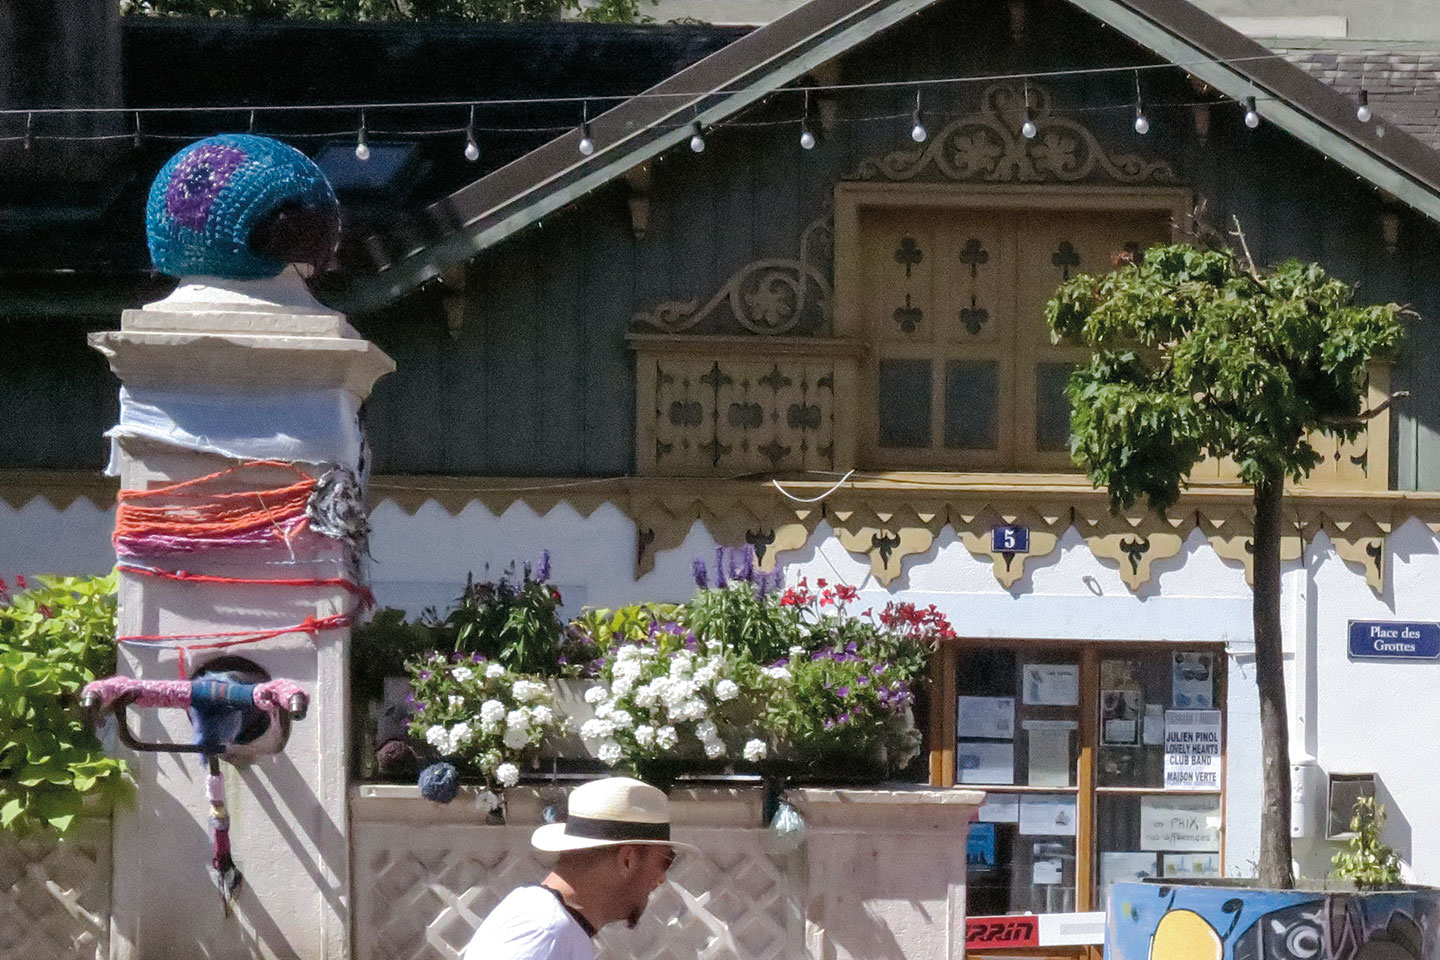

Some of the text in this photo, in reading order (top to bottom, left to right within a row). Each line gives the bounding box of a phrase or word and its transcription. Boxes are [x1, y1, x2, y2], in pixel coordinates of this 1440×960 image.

[1004, 529, 1016, 549] 5
[1370, 626, 1421, 639] Place des
[1374, 639, 1416, 651] Grottes
[1166, 732, 1218, 742] JULIEN PINOL
[1166, 744, 1218, 754] LOVELY HEARTS
[1169, 755, 1212, 765] CLUB BAND
[1167, 772, 1217, 782] MAISON VERTE
